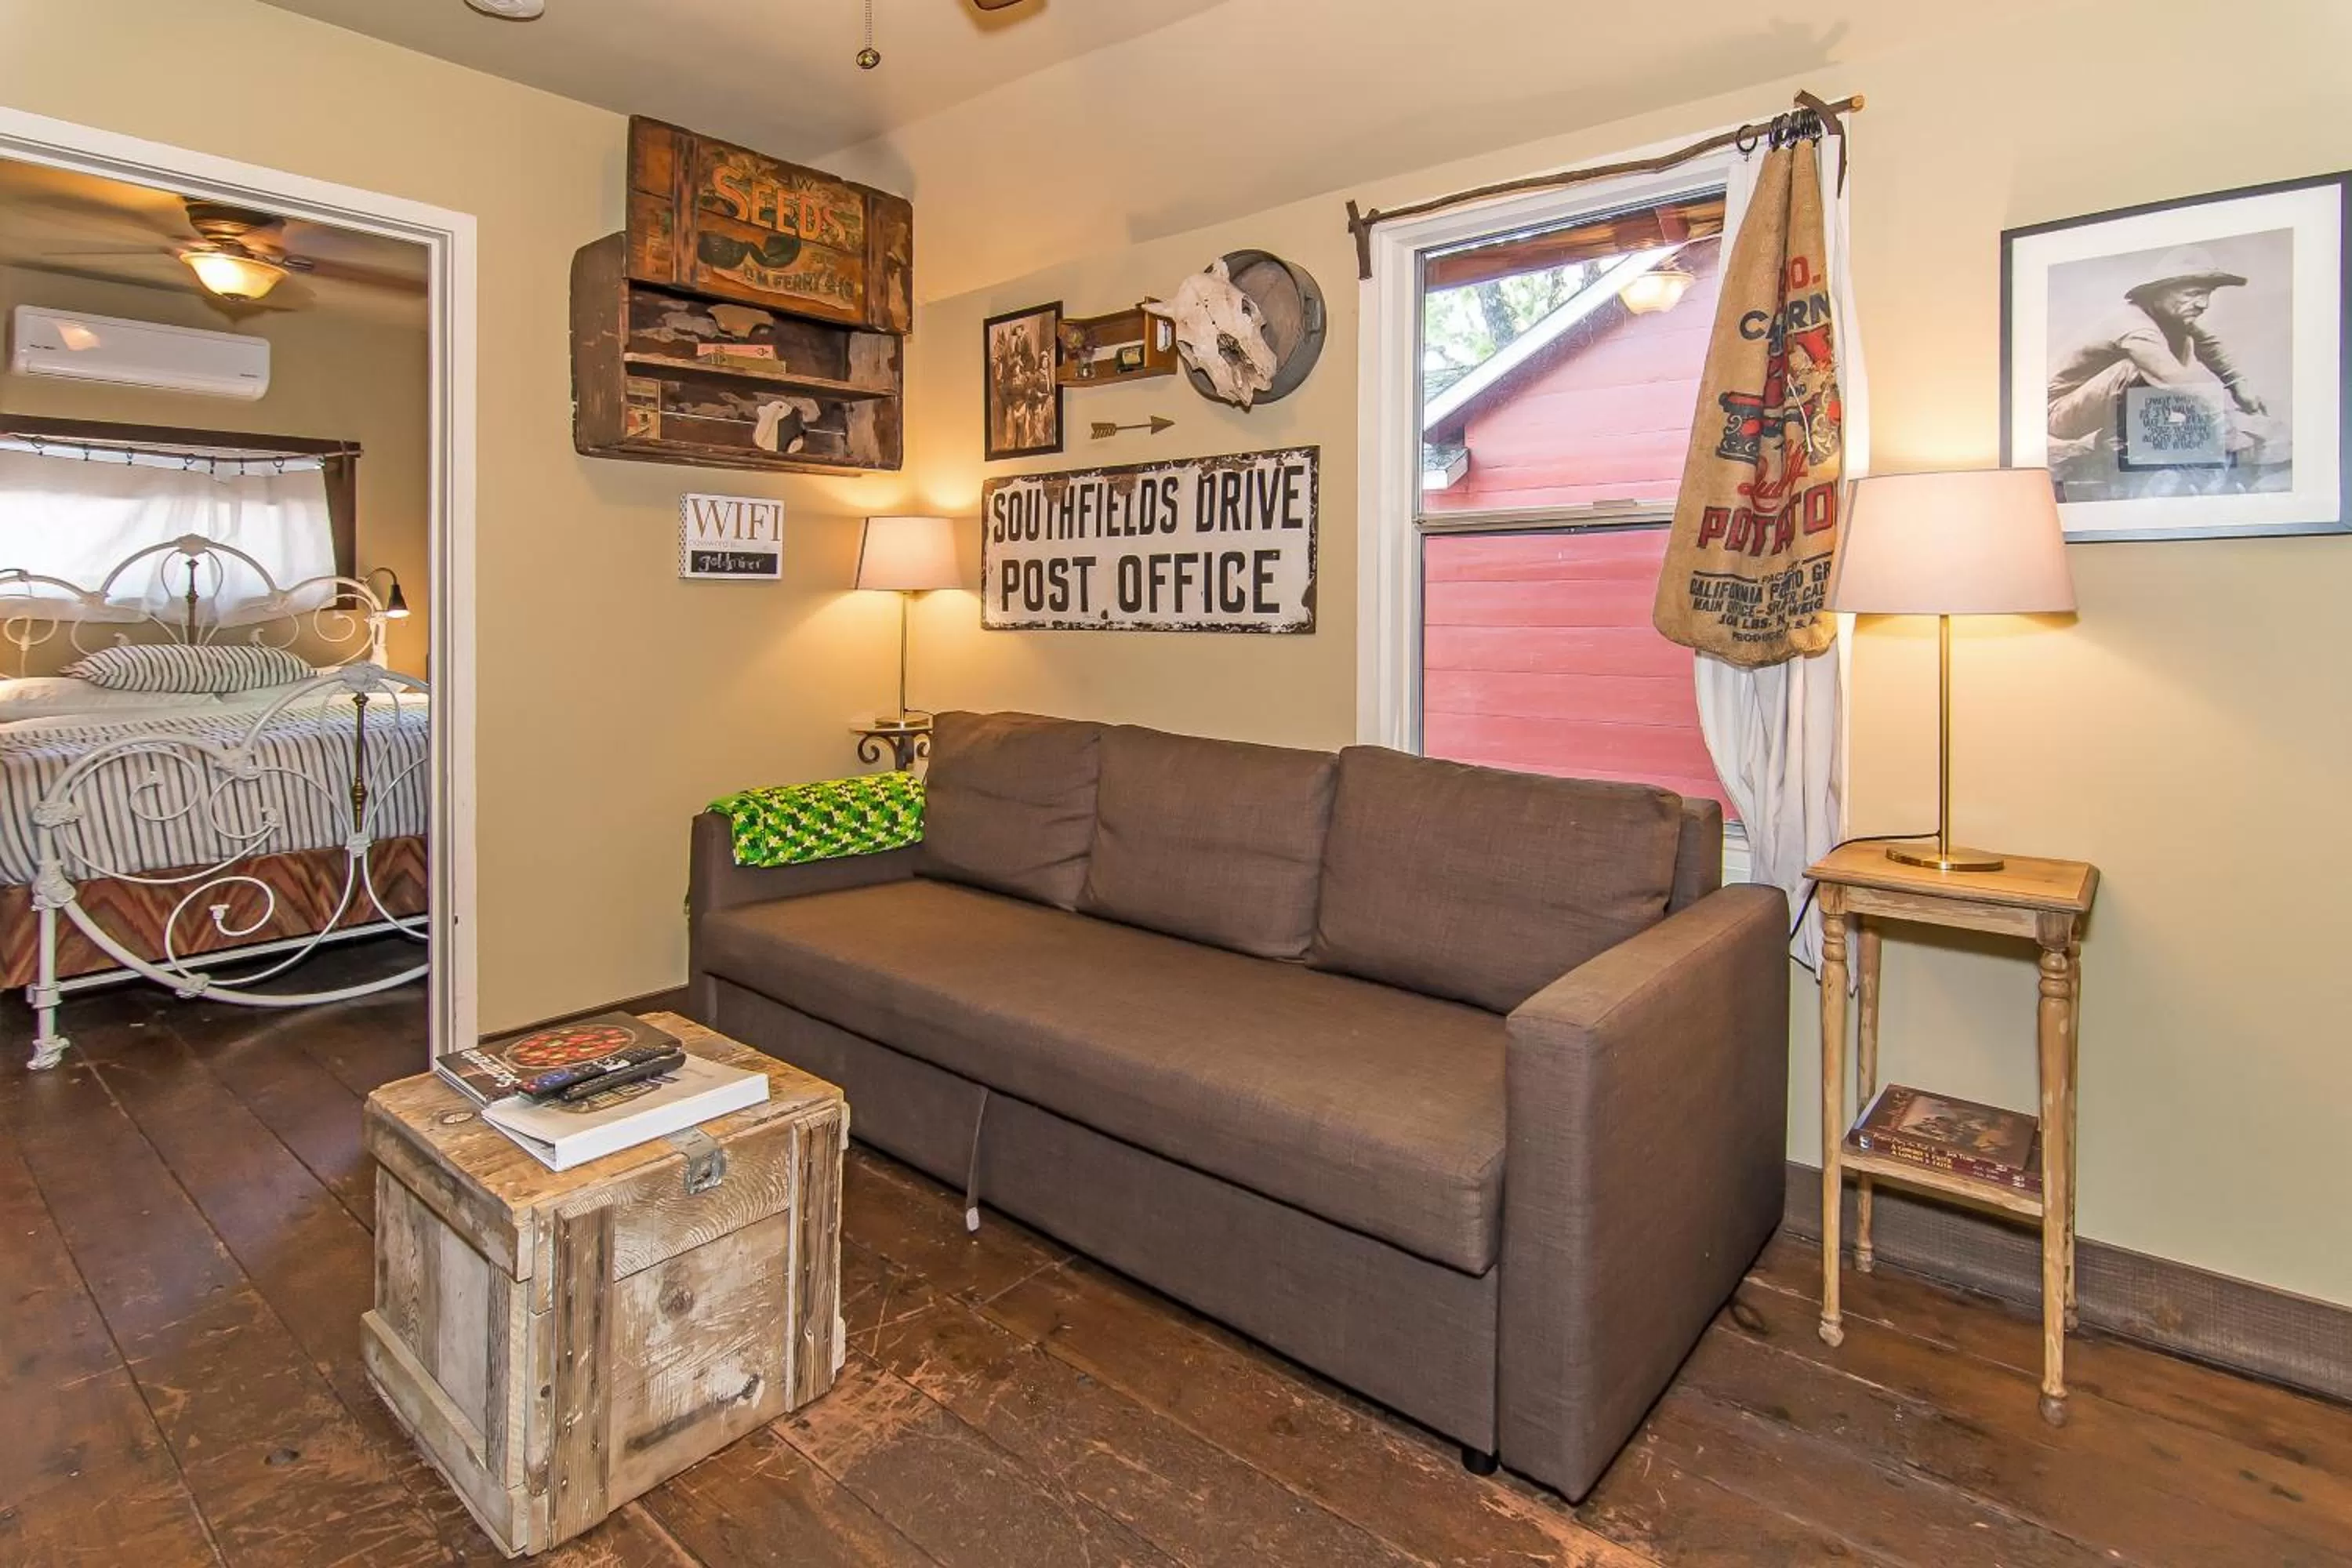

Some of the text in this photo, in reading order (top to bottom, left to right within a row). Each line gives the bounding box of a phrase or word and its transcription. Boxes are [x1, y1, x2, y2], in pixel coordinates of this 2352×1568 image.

[712, 164, 848, 251] SEEDS
[689, 499, 782, 542] WIFI
[993, 465, 1305, 543] SOUTHFIELDS DRIVE
[1001, 550, 1281, 621] POST OFFICE
[1693, 597, 1724, 612] MAIN
